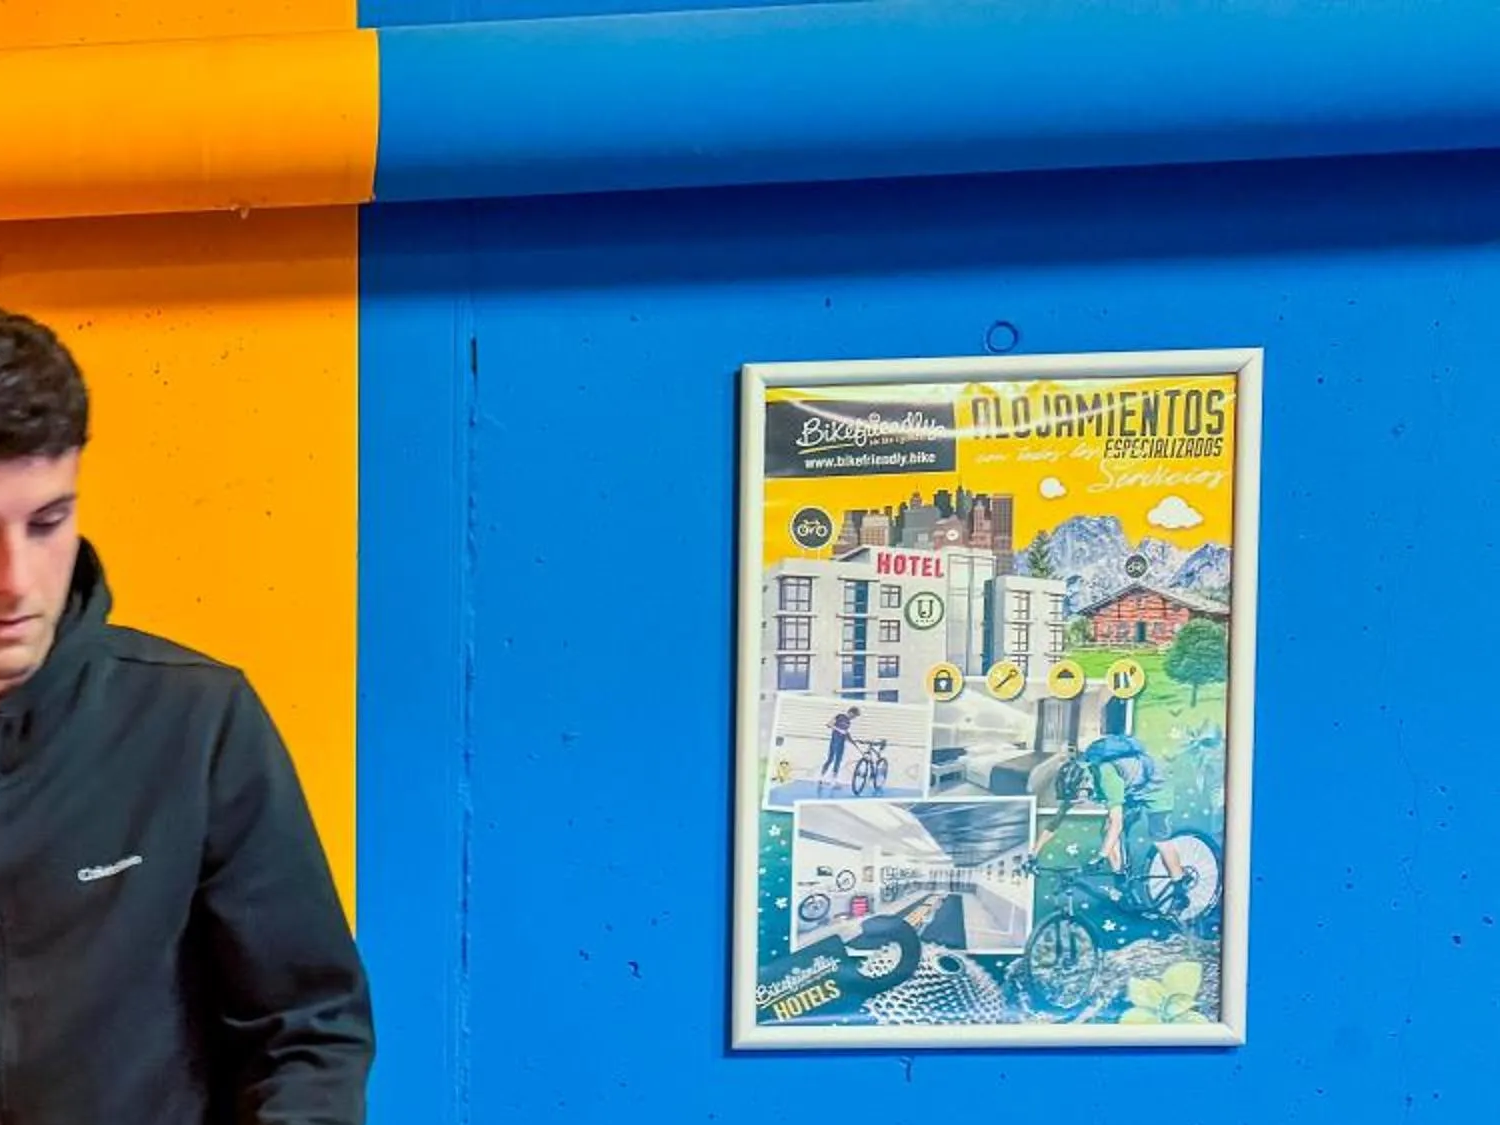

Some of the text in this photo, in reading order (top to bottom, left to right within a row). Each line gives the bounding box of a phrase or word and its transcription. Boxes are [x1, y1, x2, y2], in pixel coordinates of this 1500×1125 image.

[972, 389, 1226, 440] ALOJAMIENTOS
[803, 451, 937, 470] www.bikefriendly.bike
[1103, 437, 1224, 459] ESPECIALIZADOS
[876, 551, 945, 579] HOTEL
[772, 979, 841, 1023] HOTELS
